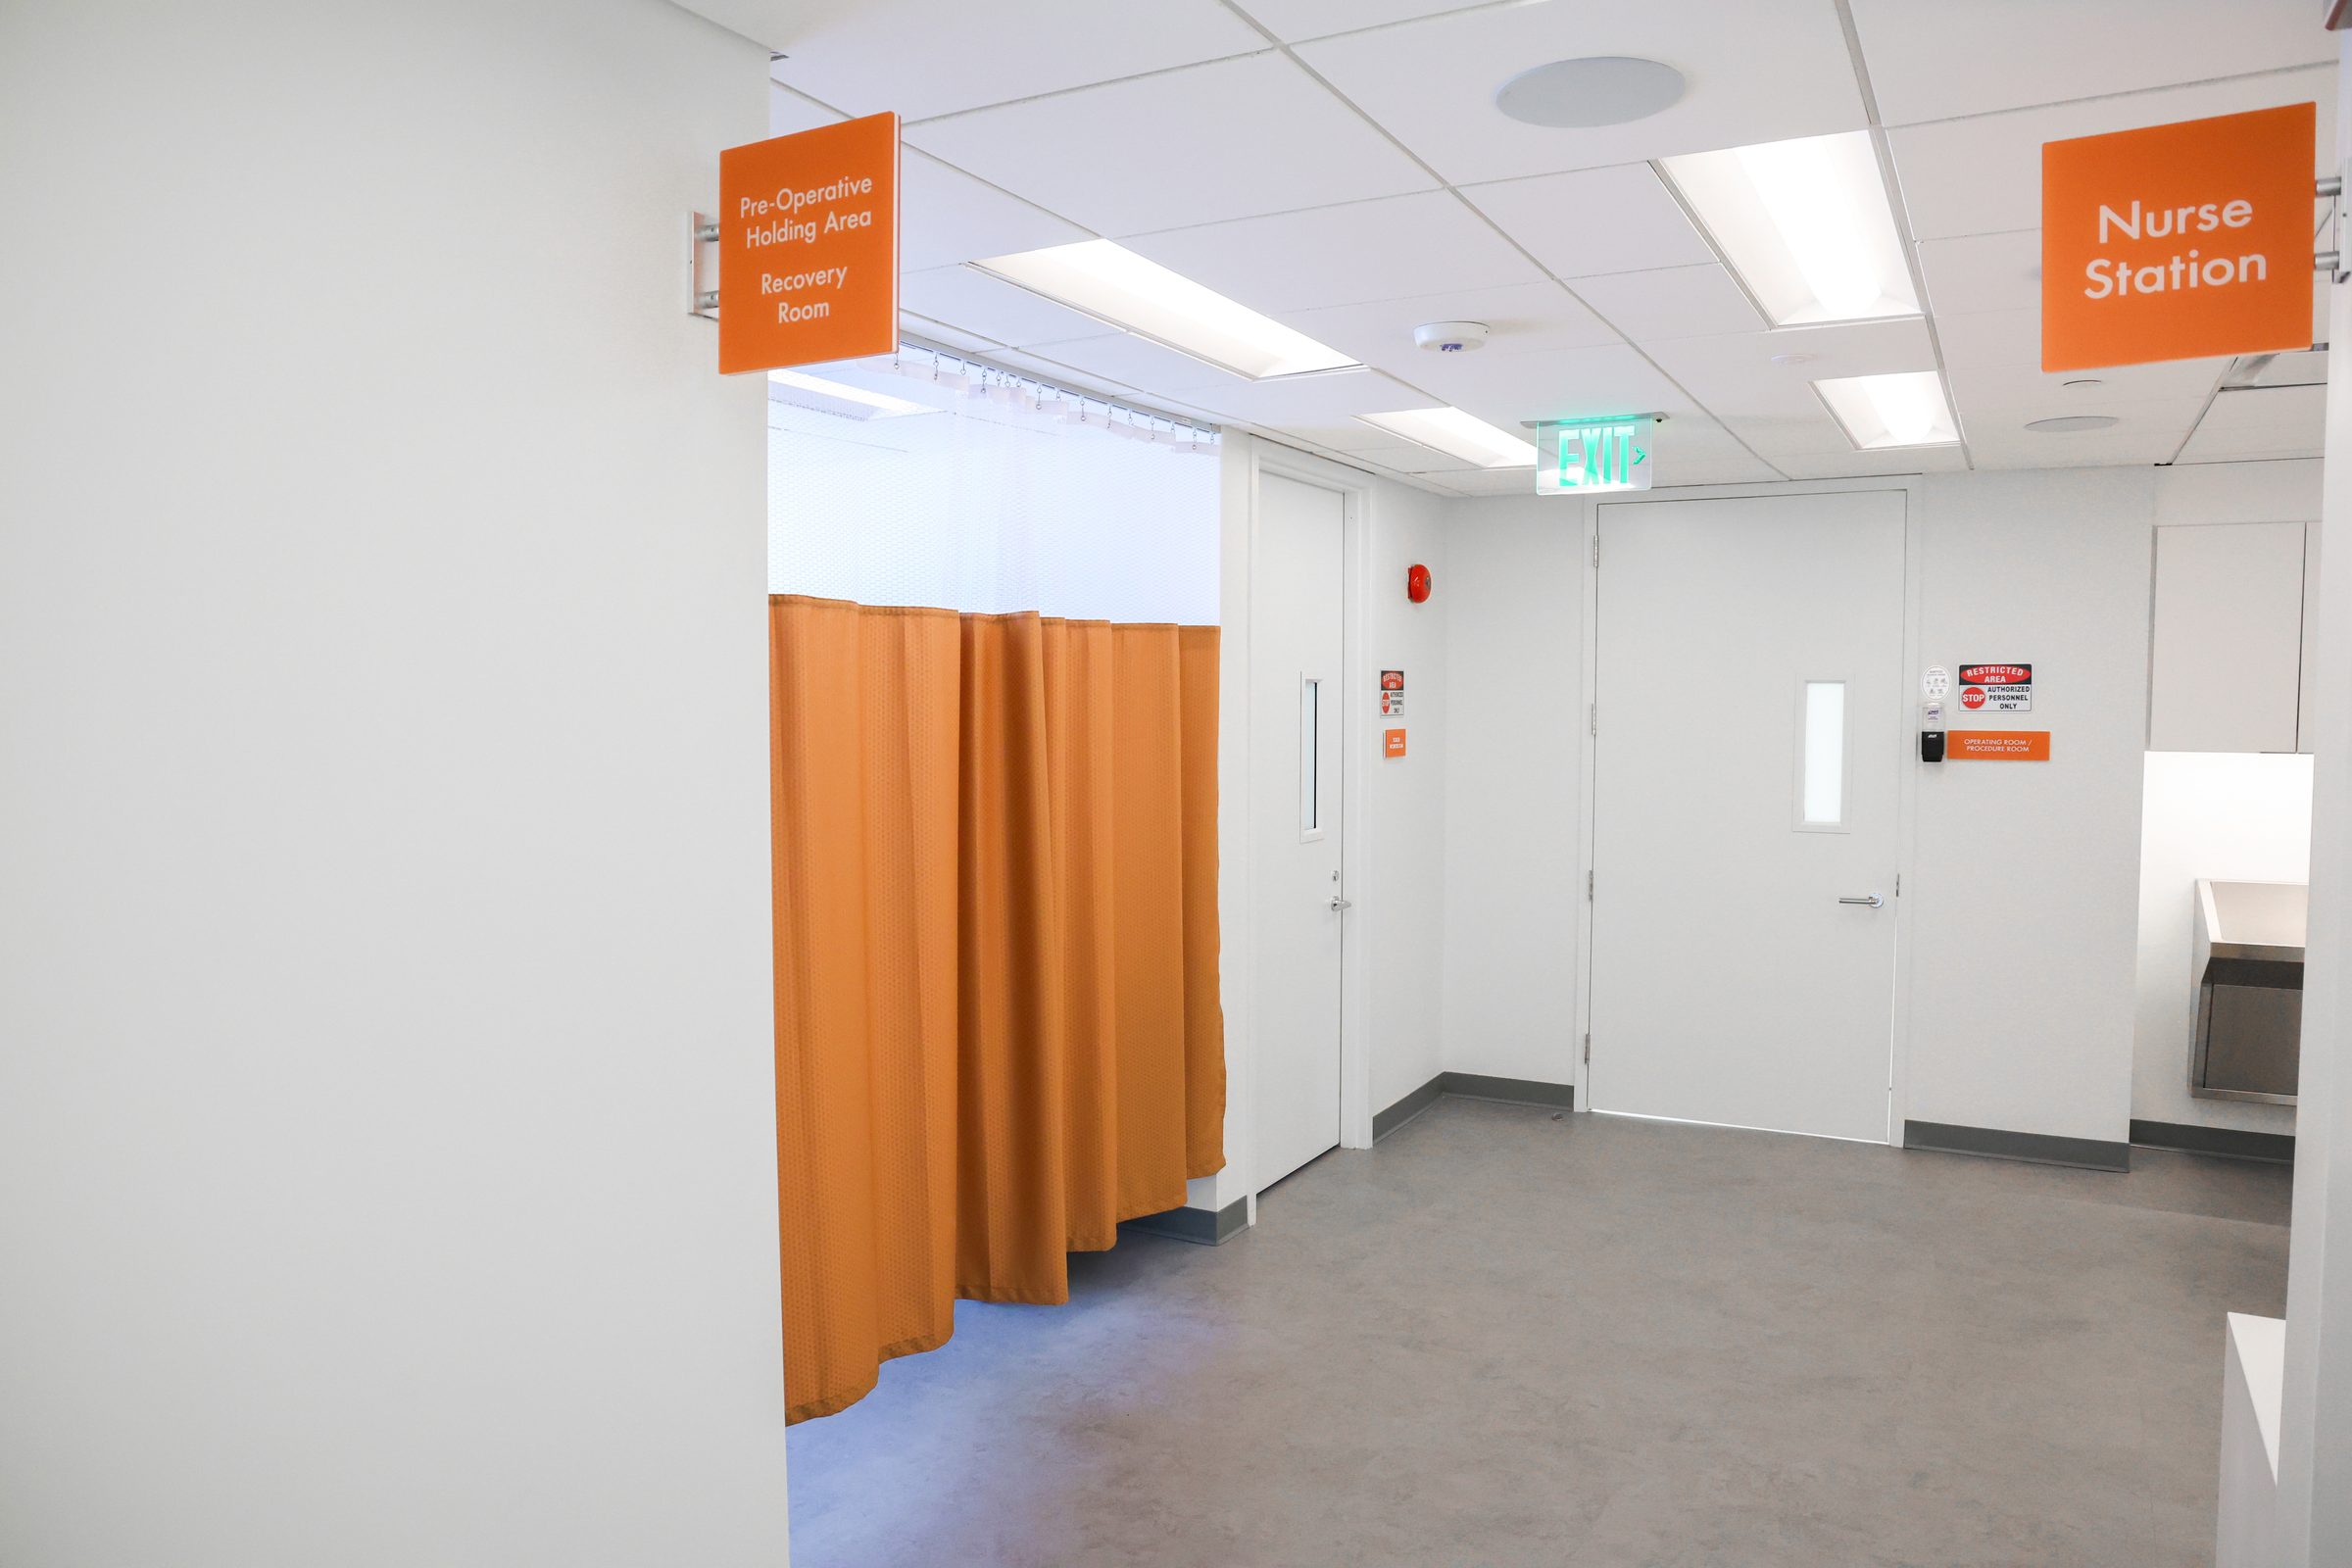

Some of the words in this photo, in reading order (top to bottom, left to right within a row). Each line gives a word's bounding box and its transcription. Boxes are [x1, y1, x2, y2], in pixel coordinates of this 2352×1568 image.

[740, 176, 872, 219] Pre-Operative
[746, 219, 816, 249] Holding
[823, 211, 871, 233] Area
[2098, 200, 2253, 244] Nurse
[761, 267, 848, 295] Recovery
[2084, 250, 2267, 299] Station
[778, 302, 830, 323] Room
[1558, 425, 1636, 486] EXIT
[1966, 666, 2024, 677] RESTRICTED
[1962, 694, 1984, 703] STOP
